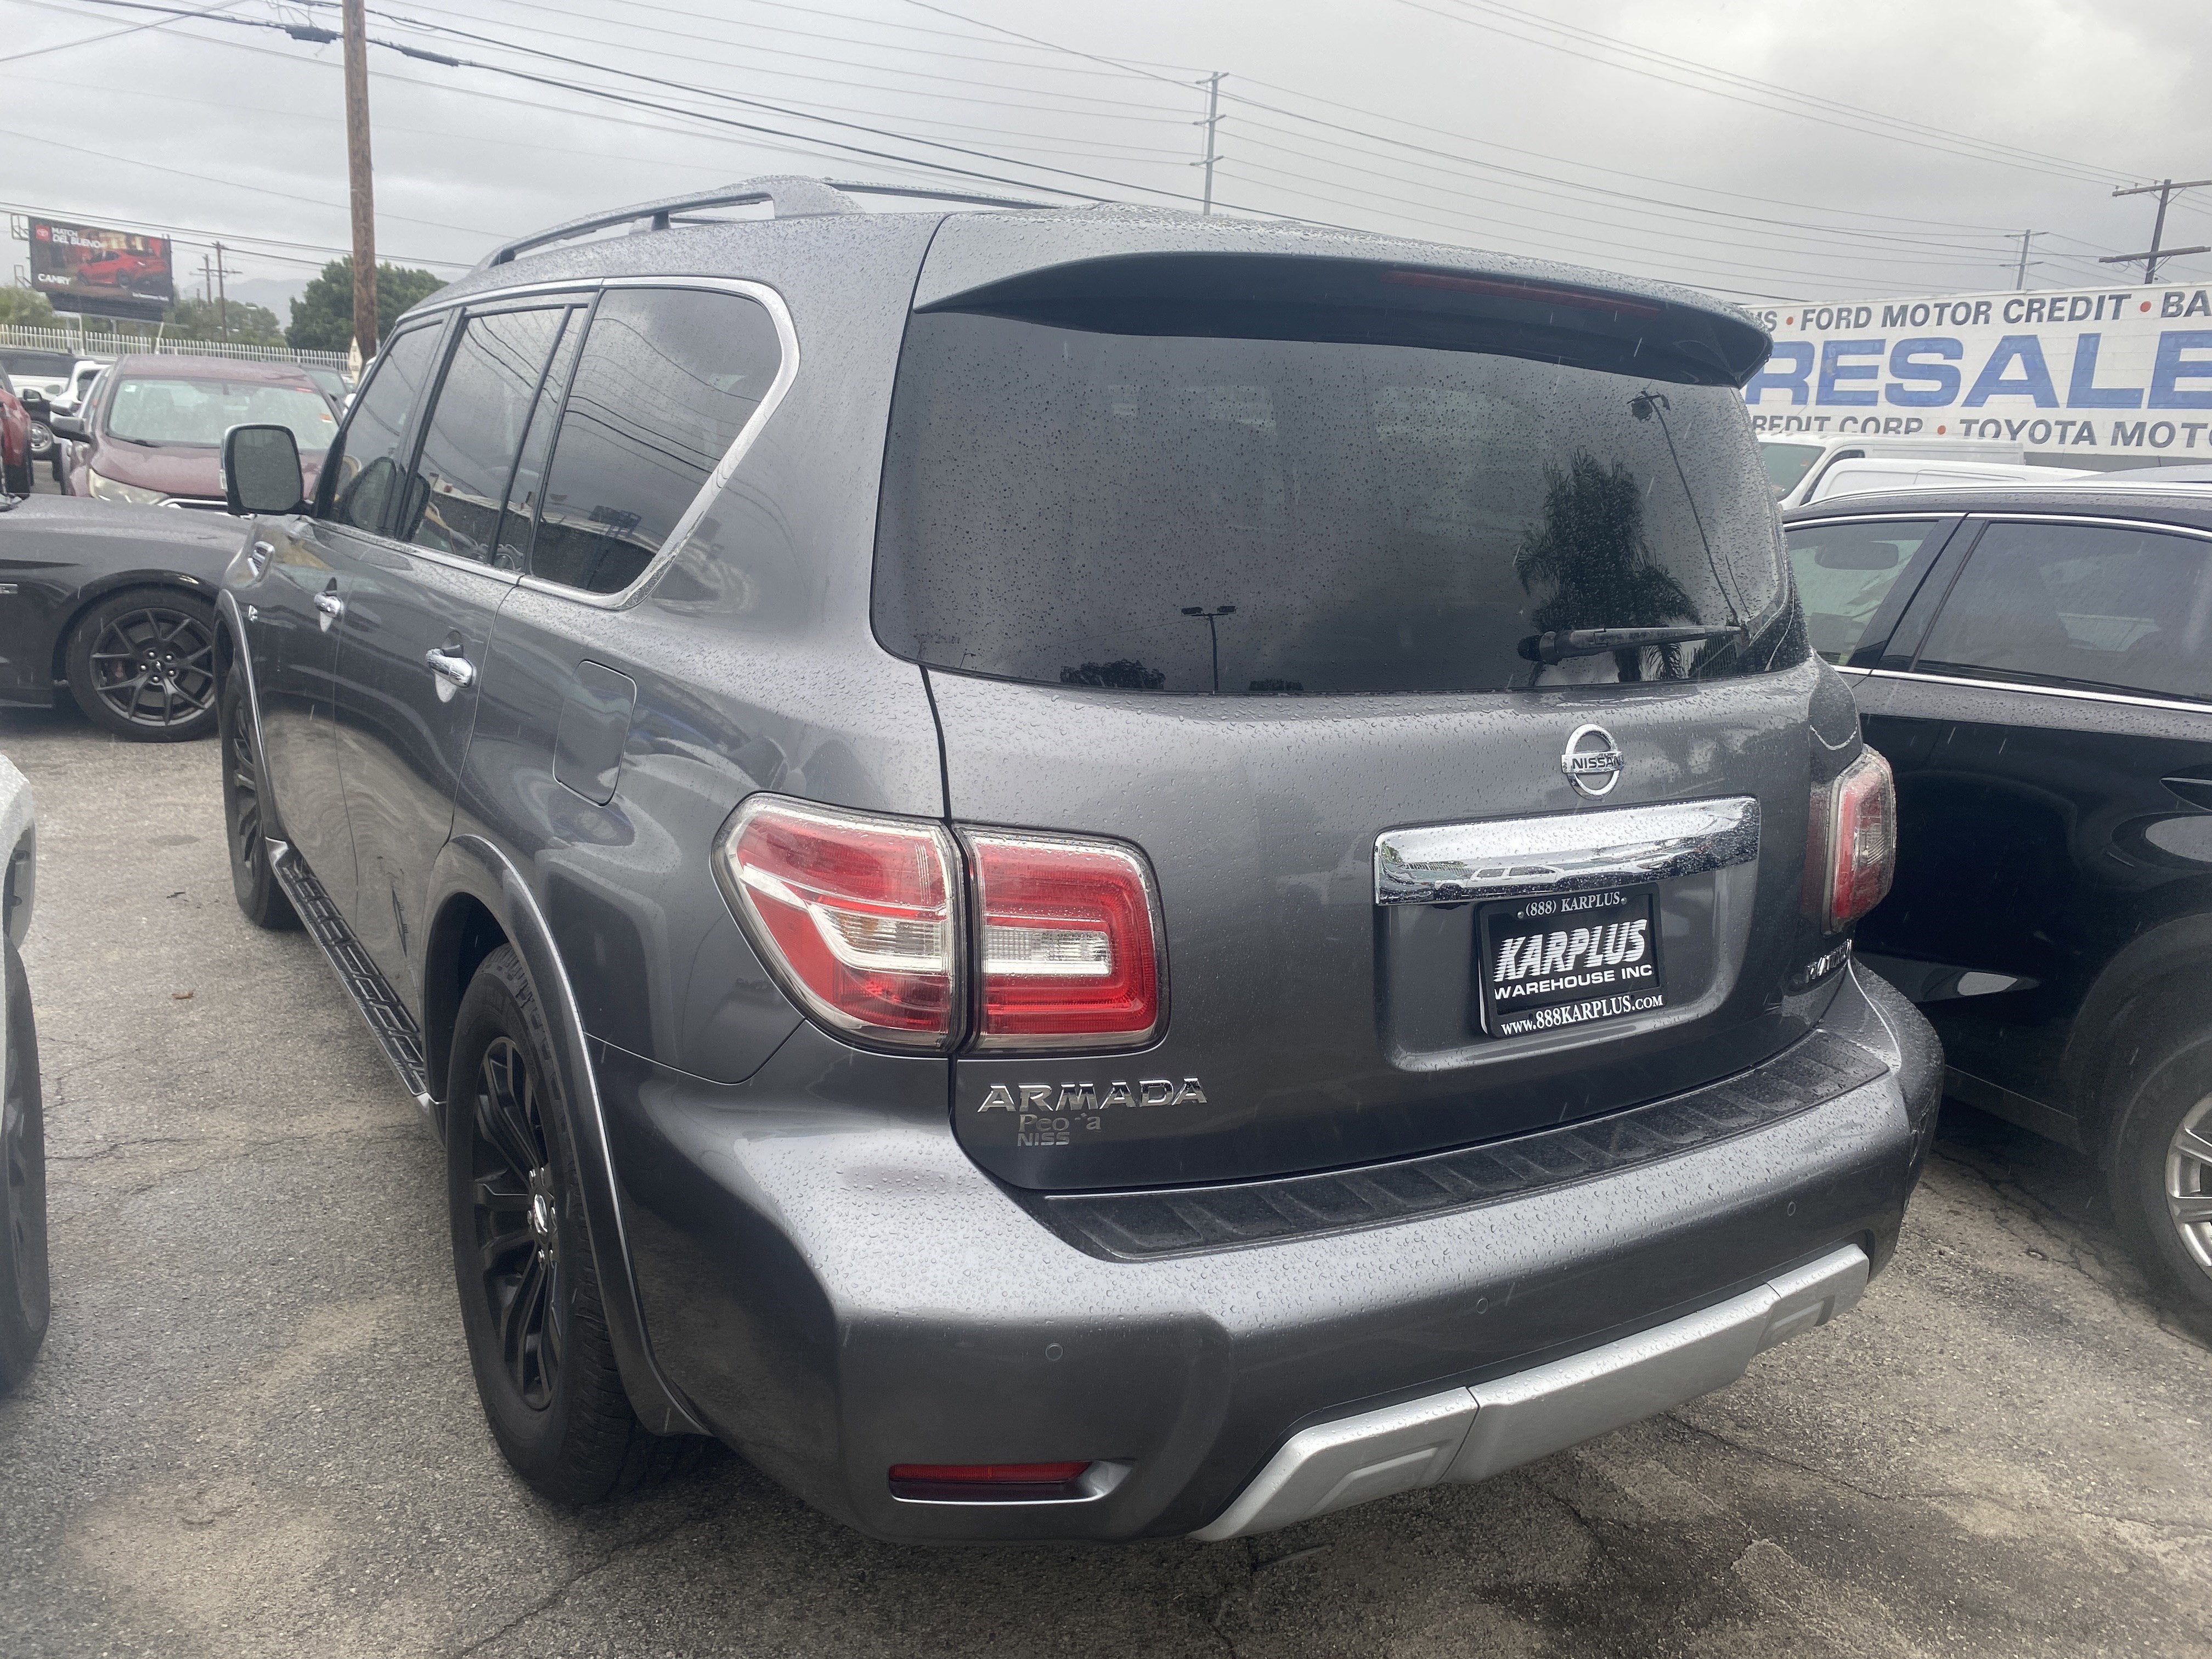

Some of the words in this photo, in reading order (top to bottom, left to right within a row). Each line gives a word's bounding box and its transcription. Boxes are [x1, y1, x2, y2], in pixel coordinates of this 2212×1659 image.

[53, 234, 69, 245] DEL
[71, 236, 101, 249] BUENO
[38, 273, 71, 285] CAMRY
[1801, 306, 1872, 331] FORD
[1881, 301, 1993, 328] MOTOR
[2003, 293, 2132, 324] CREDIT
[1745, 329, 2212, 409] RESALE
[1752, 415, 1831, 432] REDIT
[1959, 418, 2097, 445] TOYOTA
[2110, 421, 2212, 448] MOT
[1572, 755, 1622, 769] NISSAN
[1525, 899, 1557, 917] (888)
[1561, 891, 1620, 913] KARPLUS
[1493, 918, 1647, 983] KARPLUS
[1494, 969, 1615, 1000] WAREHOUSE
[1621, 964, 1652, 980] INC
[977, 1076, 1208, 1113] ARMADA
[1018, 1113, 1101, 1132] Peoa
